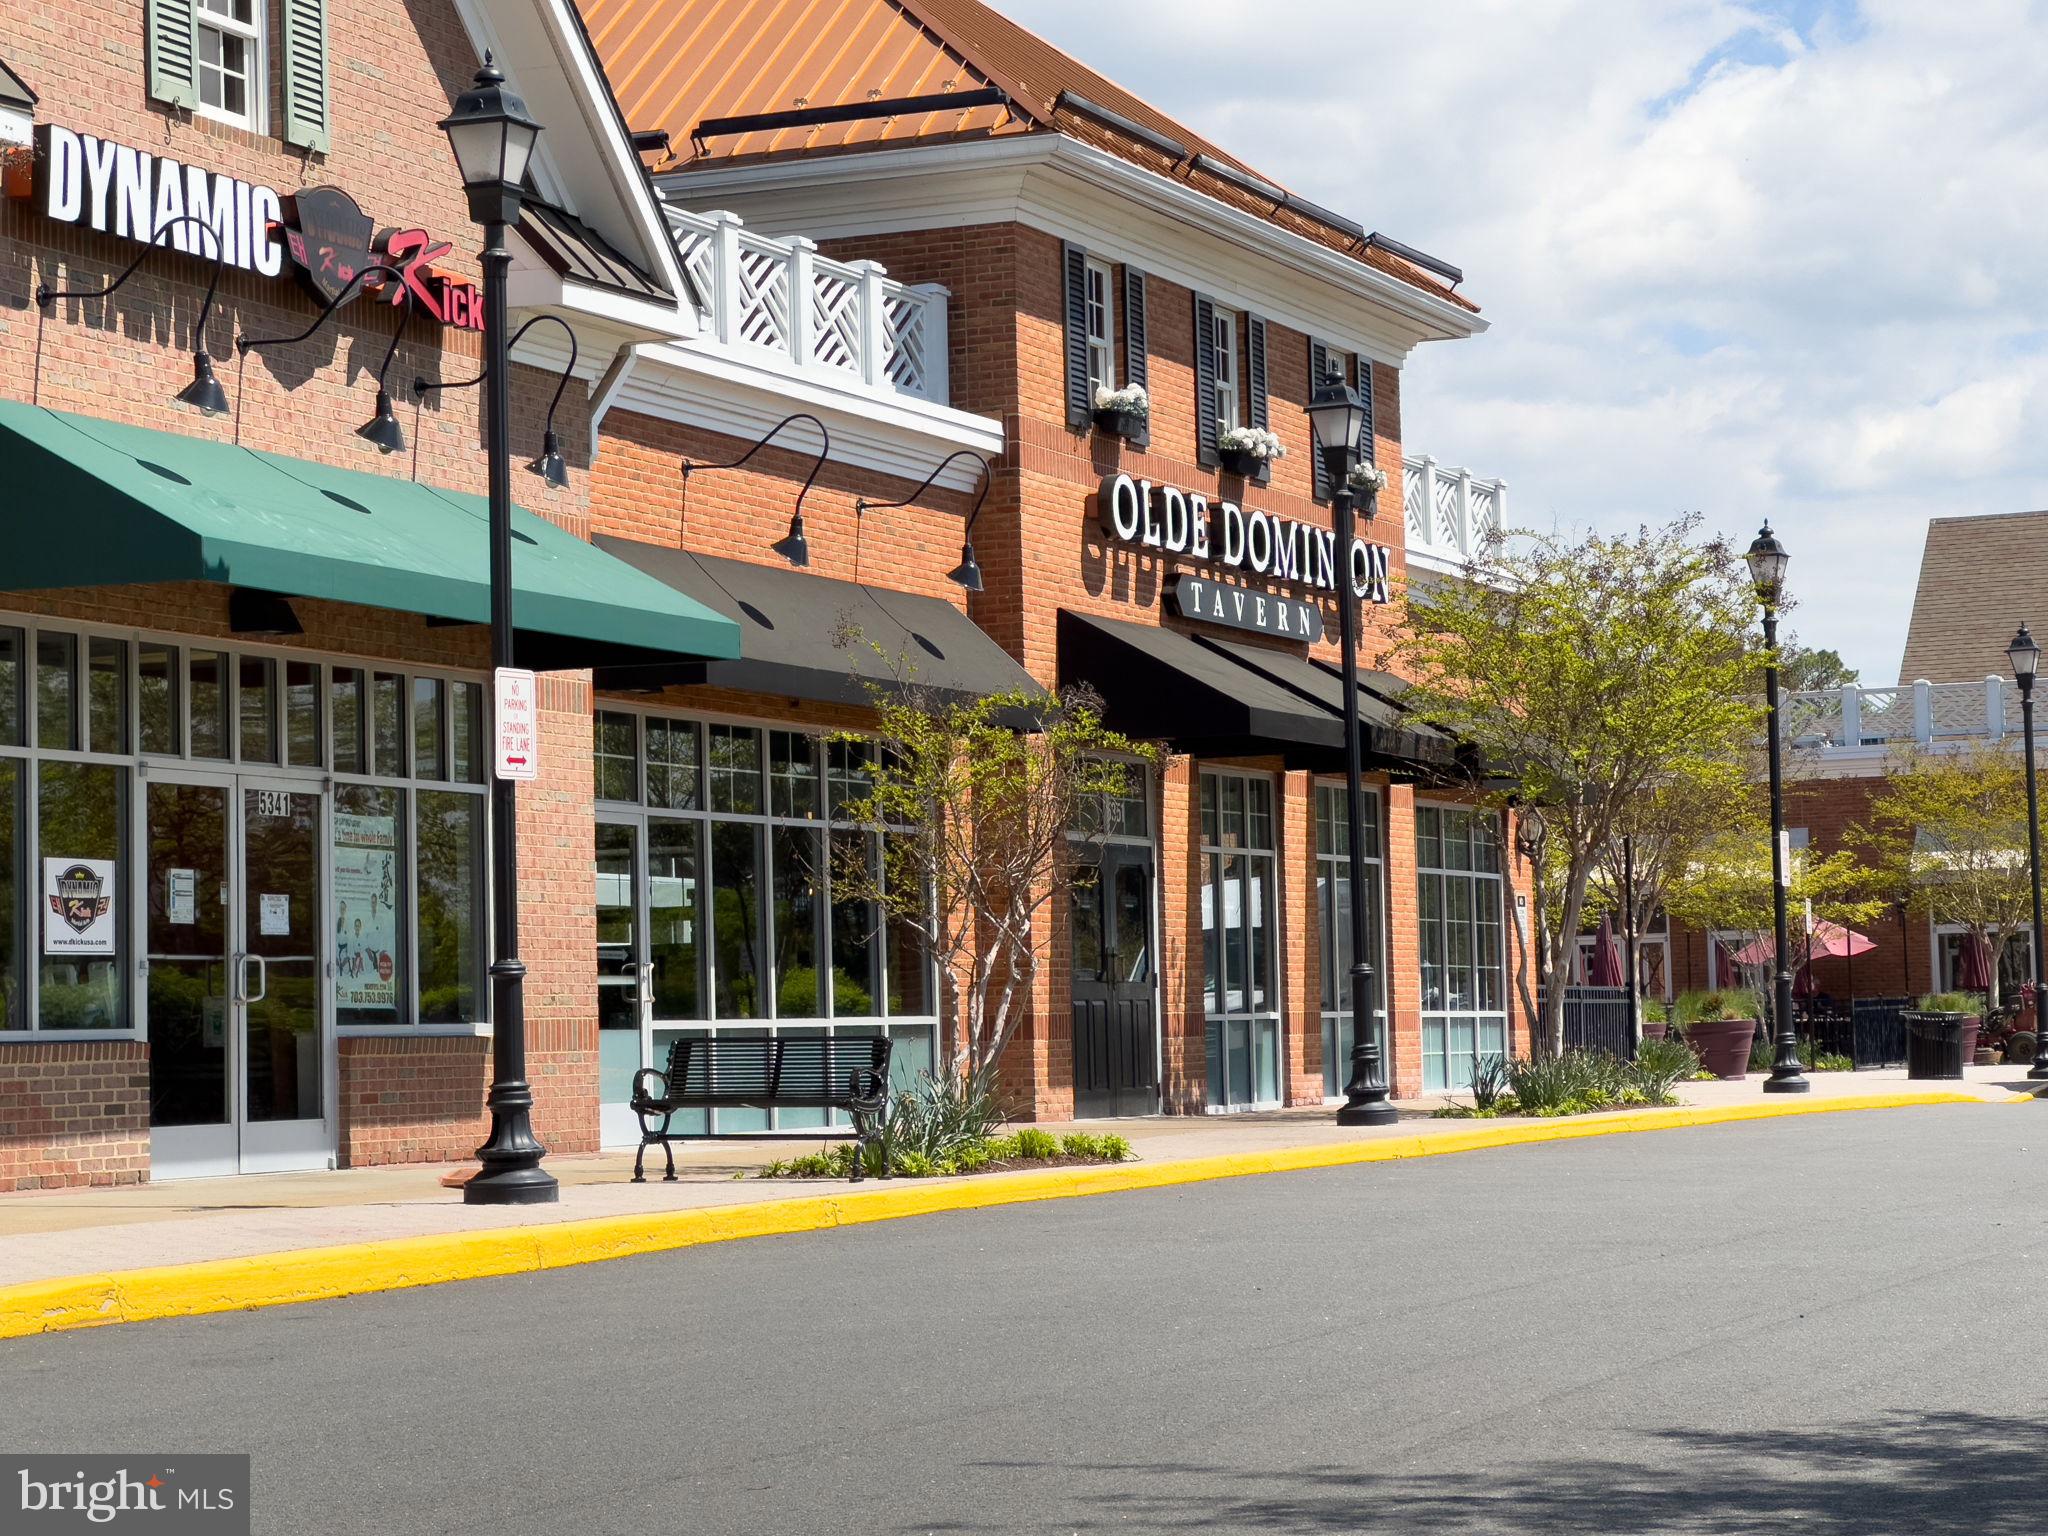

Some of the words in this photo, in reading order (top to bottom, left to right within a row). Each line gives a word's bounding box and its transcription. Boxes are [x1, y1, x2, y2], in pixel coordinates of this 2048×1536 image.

[48, 123, 282, 277] DYNAMIC
[1112, 474, 1209, 559] OLDE
[1222, 501, 1391, 605] DOMINON
[1191, 582, 1311, 637] TAVERN
[511, 684, 520, 696] NO
[504, 698, 528, 712] PARKING
[503, 721, 530, 735] STANDING
[502, 736, 514, 751] FIRE
[516, 737, 530, 752] LANE
[259, 792, 290, 816] 5341
[61, 881, 99, 899] DYNAMIC
